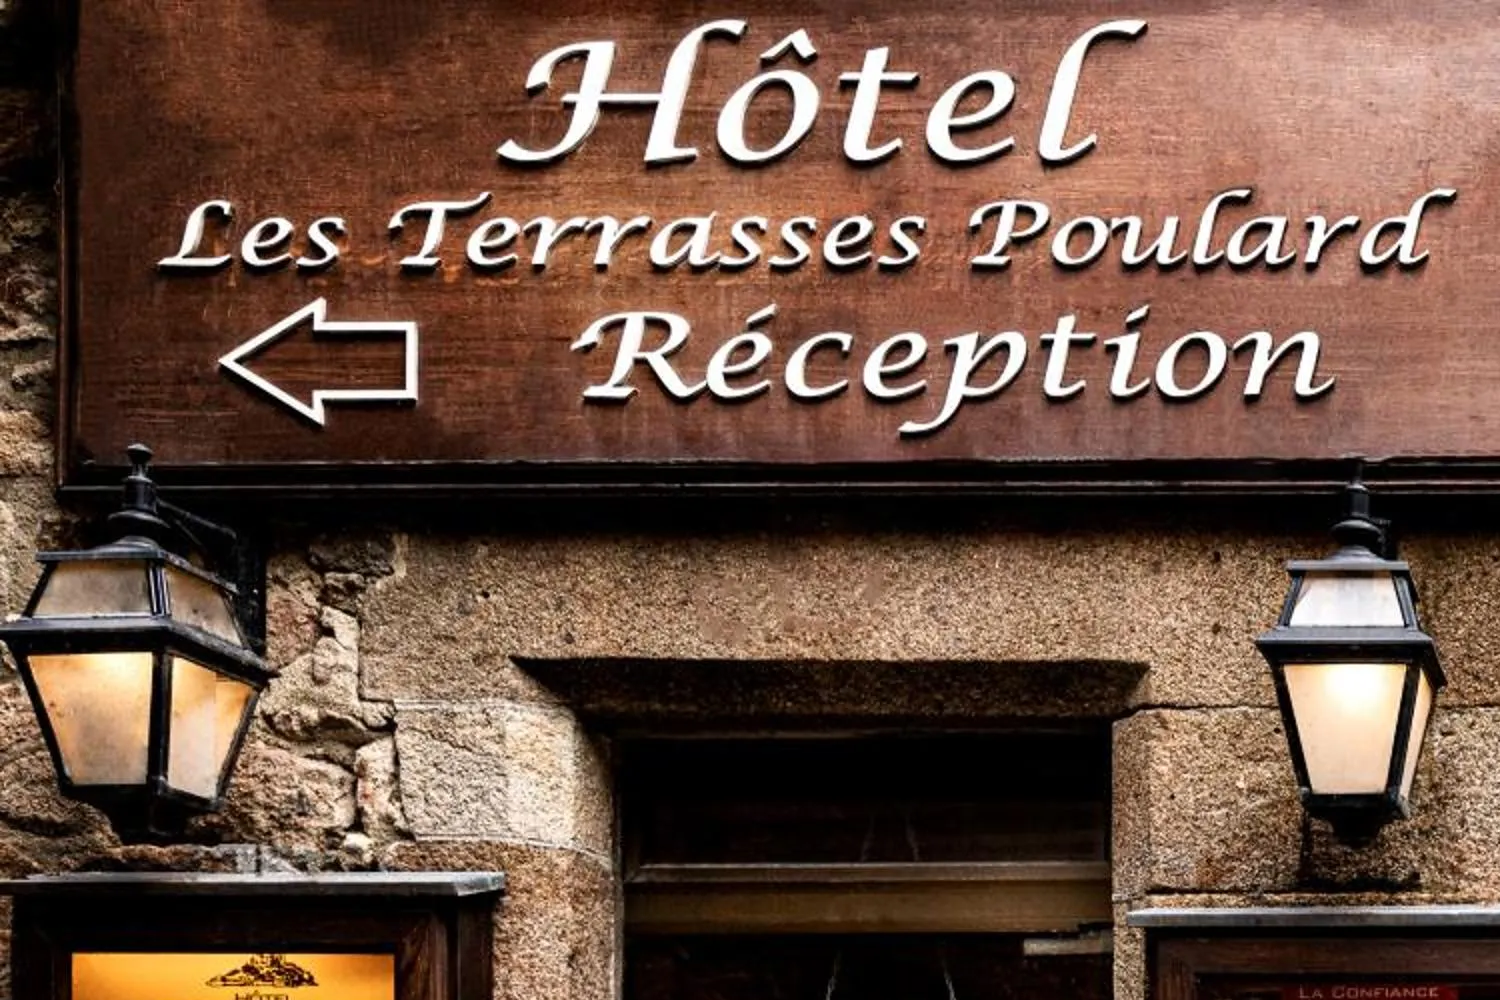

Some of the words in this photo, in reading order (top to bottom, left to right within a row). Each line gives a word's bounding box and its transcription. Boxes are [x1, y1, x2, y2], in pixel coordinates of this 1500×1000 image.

[496, 17, 1148, 163] Hôtel
[157, 198, 345, 268] Les
[386, 189, 927, 268] Terrasses
[967, 186, 1458, 268] Poulard
[570, 302, 1336, 434] Réception
[1299, 987, 1322, 999] LA
[1332, 986, 1440, 999] CONFIANCE
